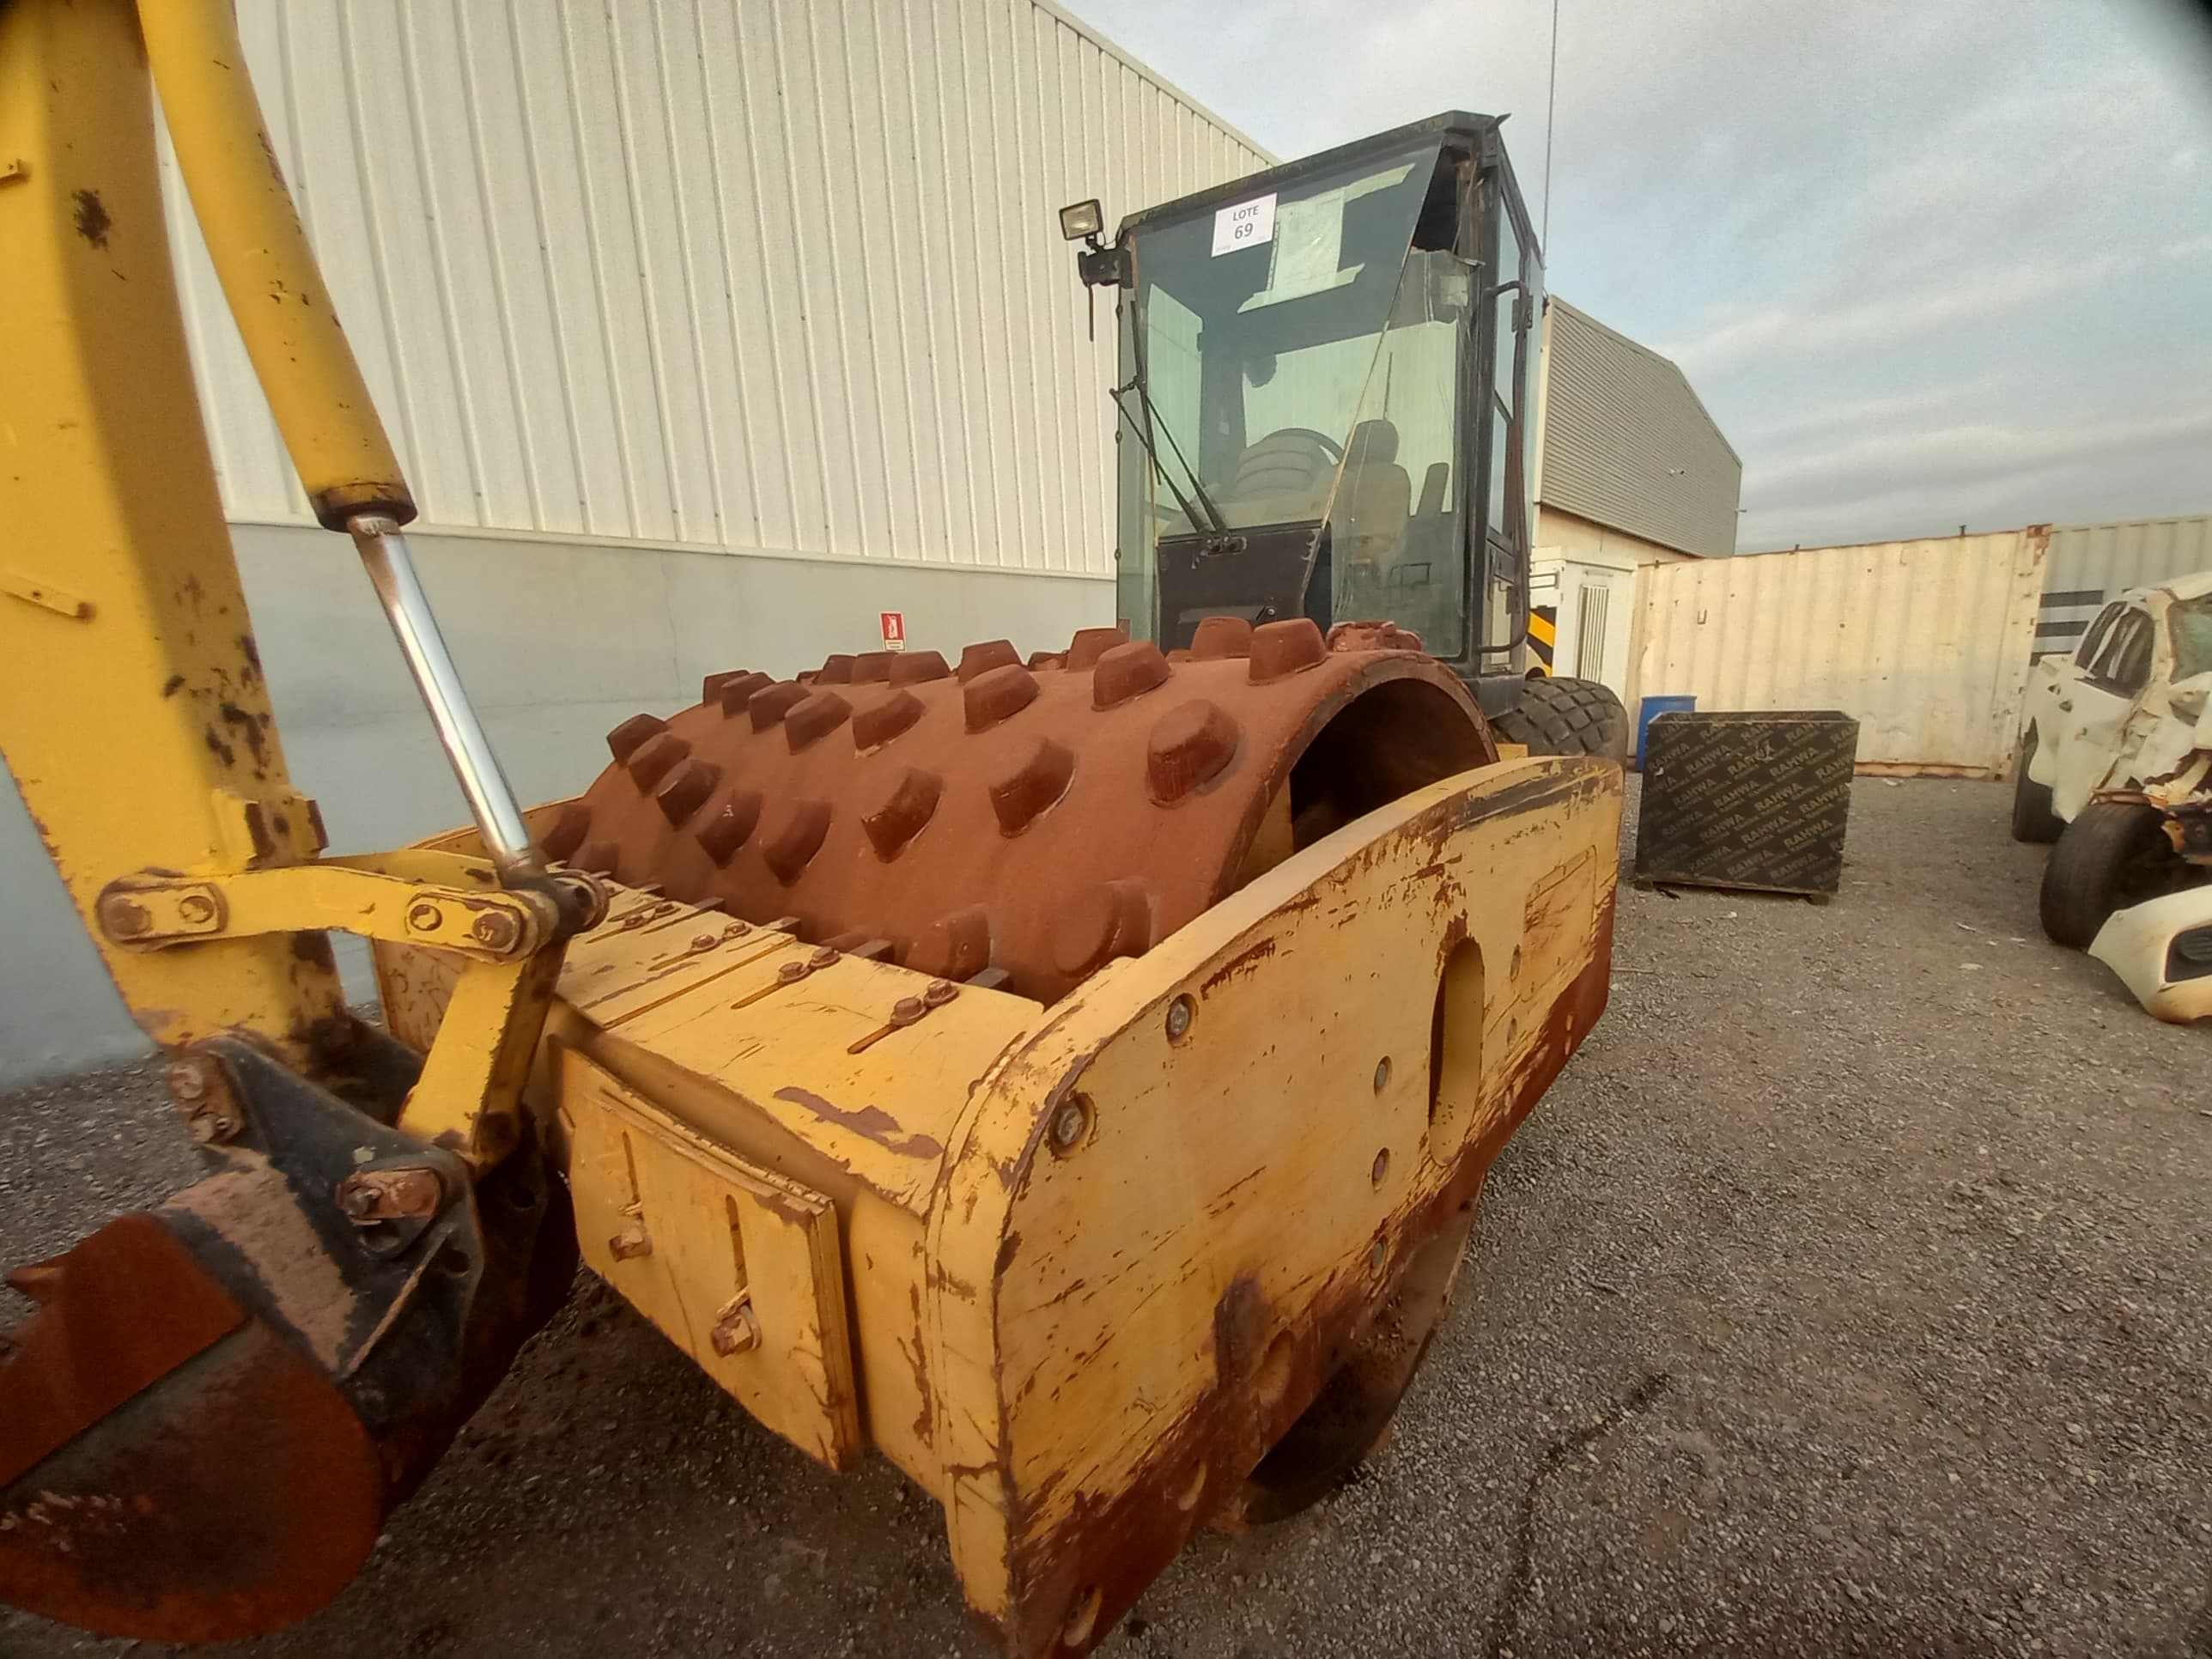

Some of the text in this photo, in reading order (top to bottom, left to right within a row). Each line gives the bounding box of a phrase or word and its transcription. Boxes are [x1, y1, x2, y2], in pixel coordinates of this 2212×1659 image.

[1232, 204, 1260, 222] LOTE
[1234, 222, 1254, 240] 69
[1686, 744, 1731, 774] RAHWA
[1769, 746, 1819, 777] RAHWA
[1814, 756, 1853, 780] RAHW
[1672, 778, 1717, 807] RAHWA
[1713, 780, 1760, 809] RAHWA
[1754, 782, 1803, 811] RAHWA
[1799, 784, 1850, 814] RAHWA
[1699, 813, 1745, 841] RAHWA
[1741, 816, 1790, 844] RAHWA
[1784, 818, 1833, 848] RAHWA
[1726, 848, 1773, 876] RAHWA
